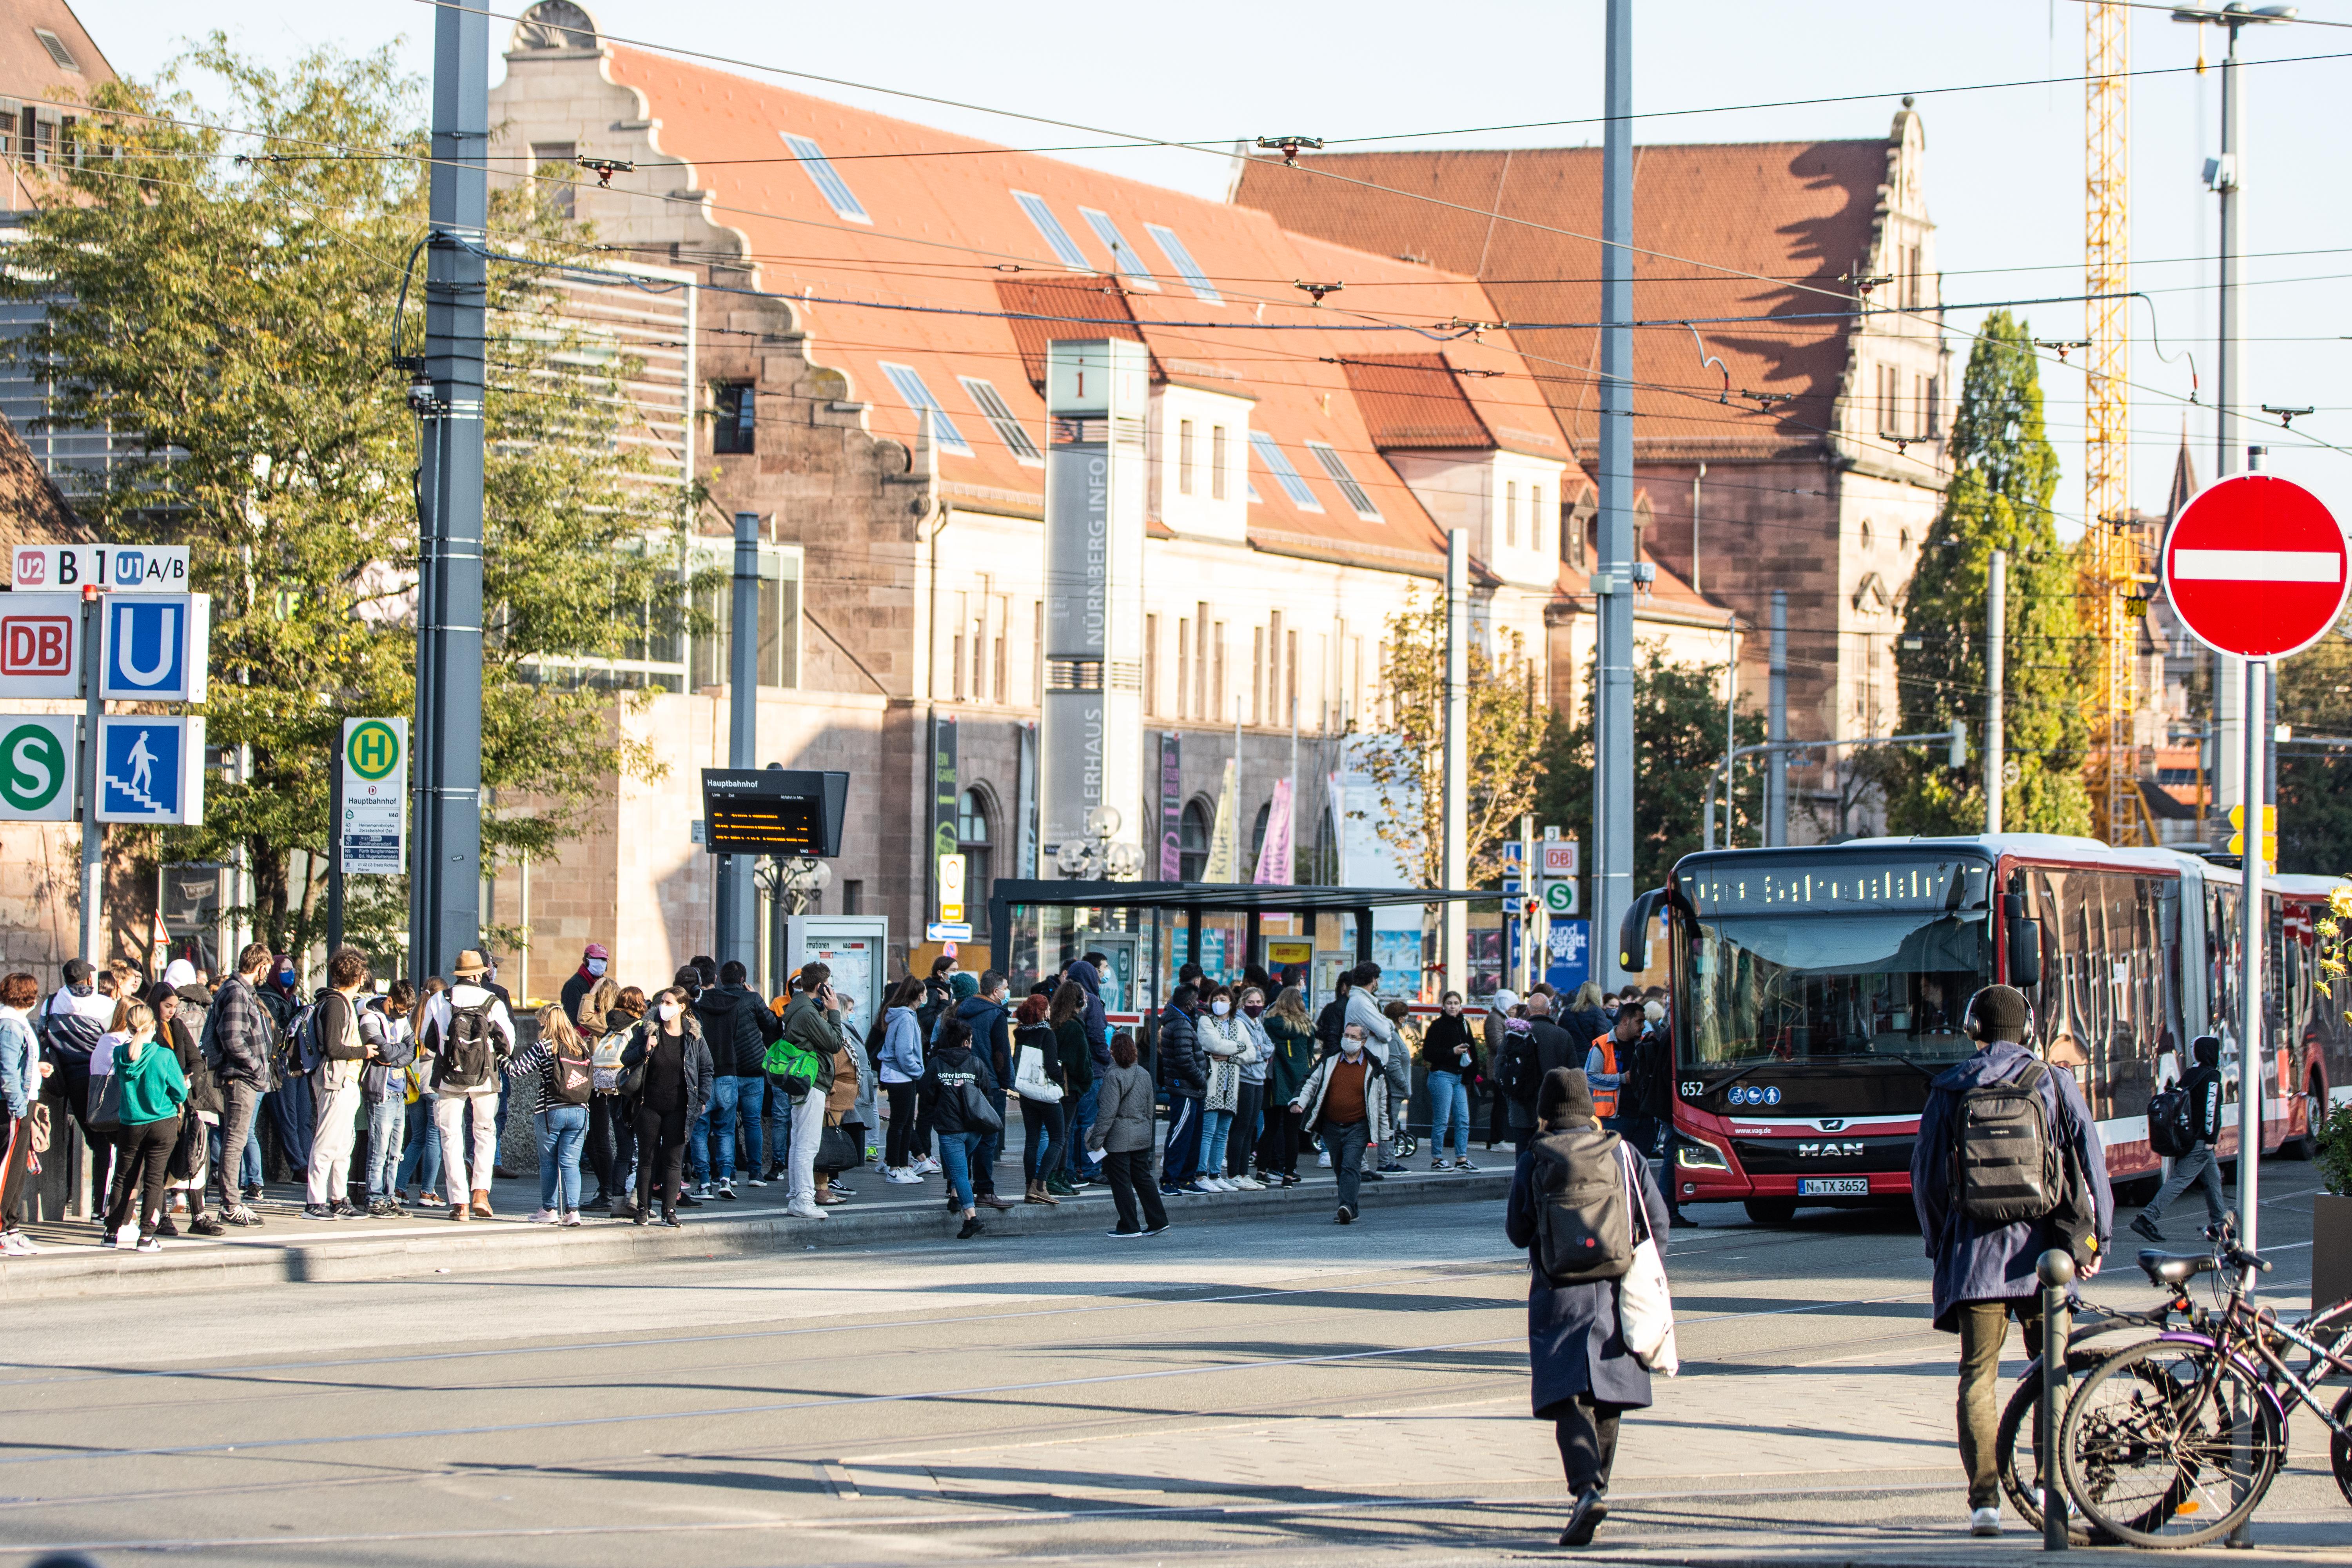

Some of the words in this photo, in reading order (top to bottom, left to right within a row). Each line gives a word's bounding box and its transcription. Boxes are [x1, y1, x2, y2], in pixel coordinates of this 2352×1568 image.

[1089, 457, 1106, 512] INFO
[19, 558, 44, 578] U2
[60, 551, 78, 584] B
[96, 551, 105, 584] 1
[118, 558, 142, 579] U1
[147, 557, 184, 582] A/B
[1082, 520, 1105, 646] NÜRNBERG
[10, 626, 62, 666] DB
[119, 608, 174, 686] U
[361, 735, 385, 766] H
[11, 737, 51, 798] S
[708, 779, 758, 788] Hauptbahnhof
[1549, 829, 1555, 839] 3
[1550, 853, 1568, 865] DB
[1551, 886, 1566, 907] S
[806, 940, 829, 949] rmationen
[566, 1076, 588, 1089] adidas
[1682, 1082, 1704, 1096] 652
[1735, 1127, 1771, 1135] www.vag.de
[1799, 1143, 1864, 1156] MAN
[1806, 1180, 1814, 1192] N
[1821, 1180, 1836, 1192] TX
[1838, 1180, 1865, 1192] 3652
